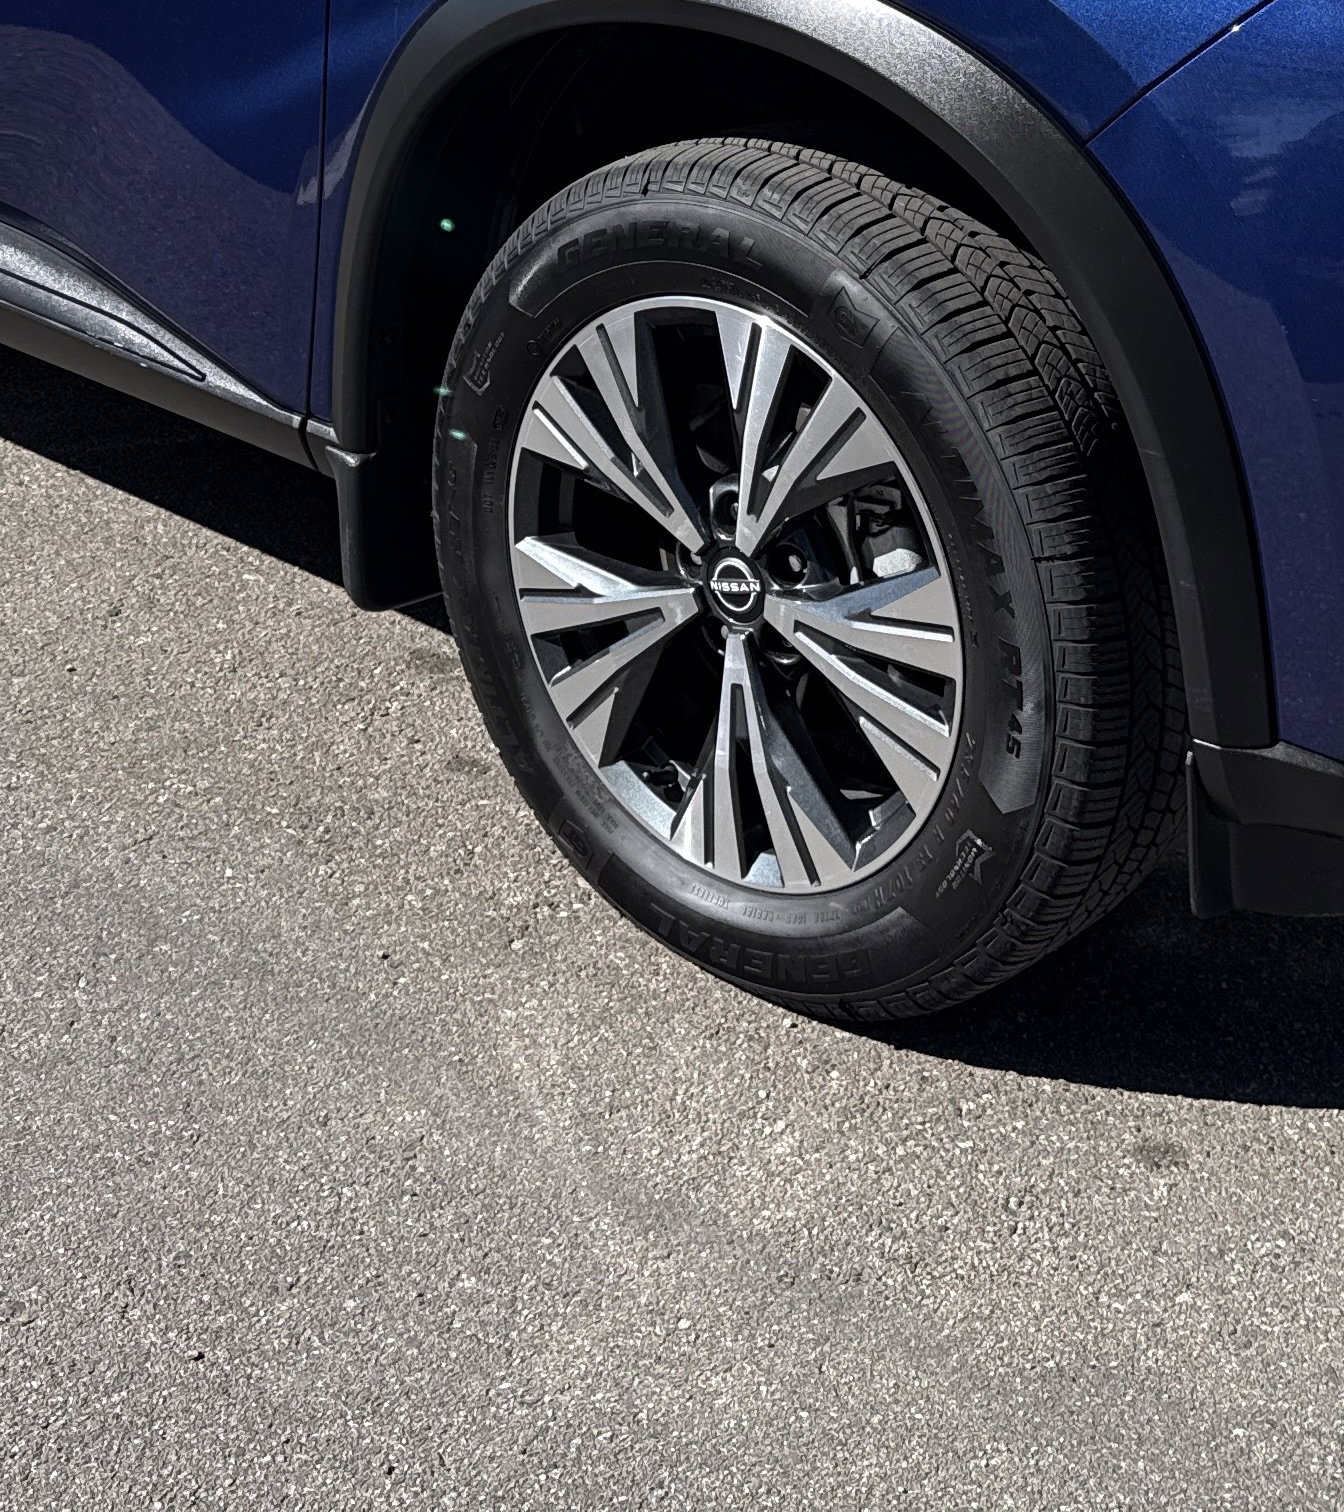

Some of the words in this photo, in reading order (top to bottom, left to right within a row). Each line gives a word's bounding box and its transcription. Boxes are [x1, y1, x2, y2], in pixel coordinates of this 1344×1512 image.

[557, 220, 763, 268] GENERAL
[709, 580, 761, 593] NISSAN
[649, 902, 874, 984] GENERAL
